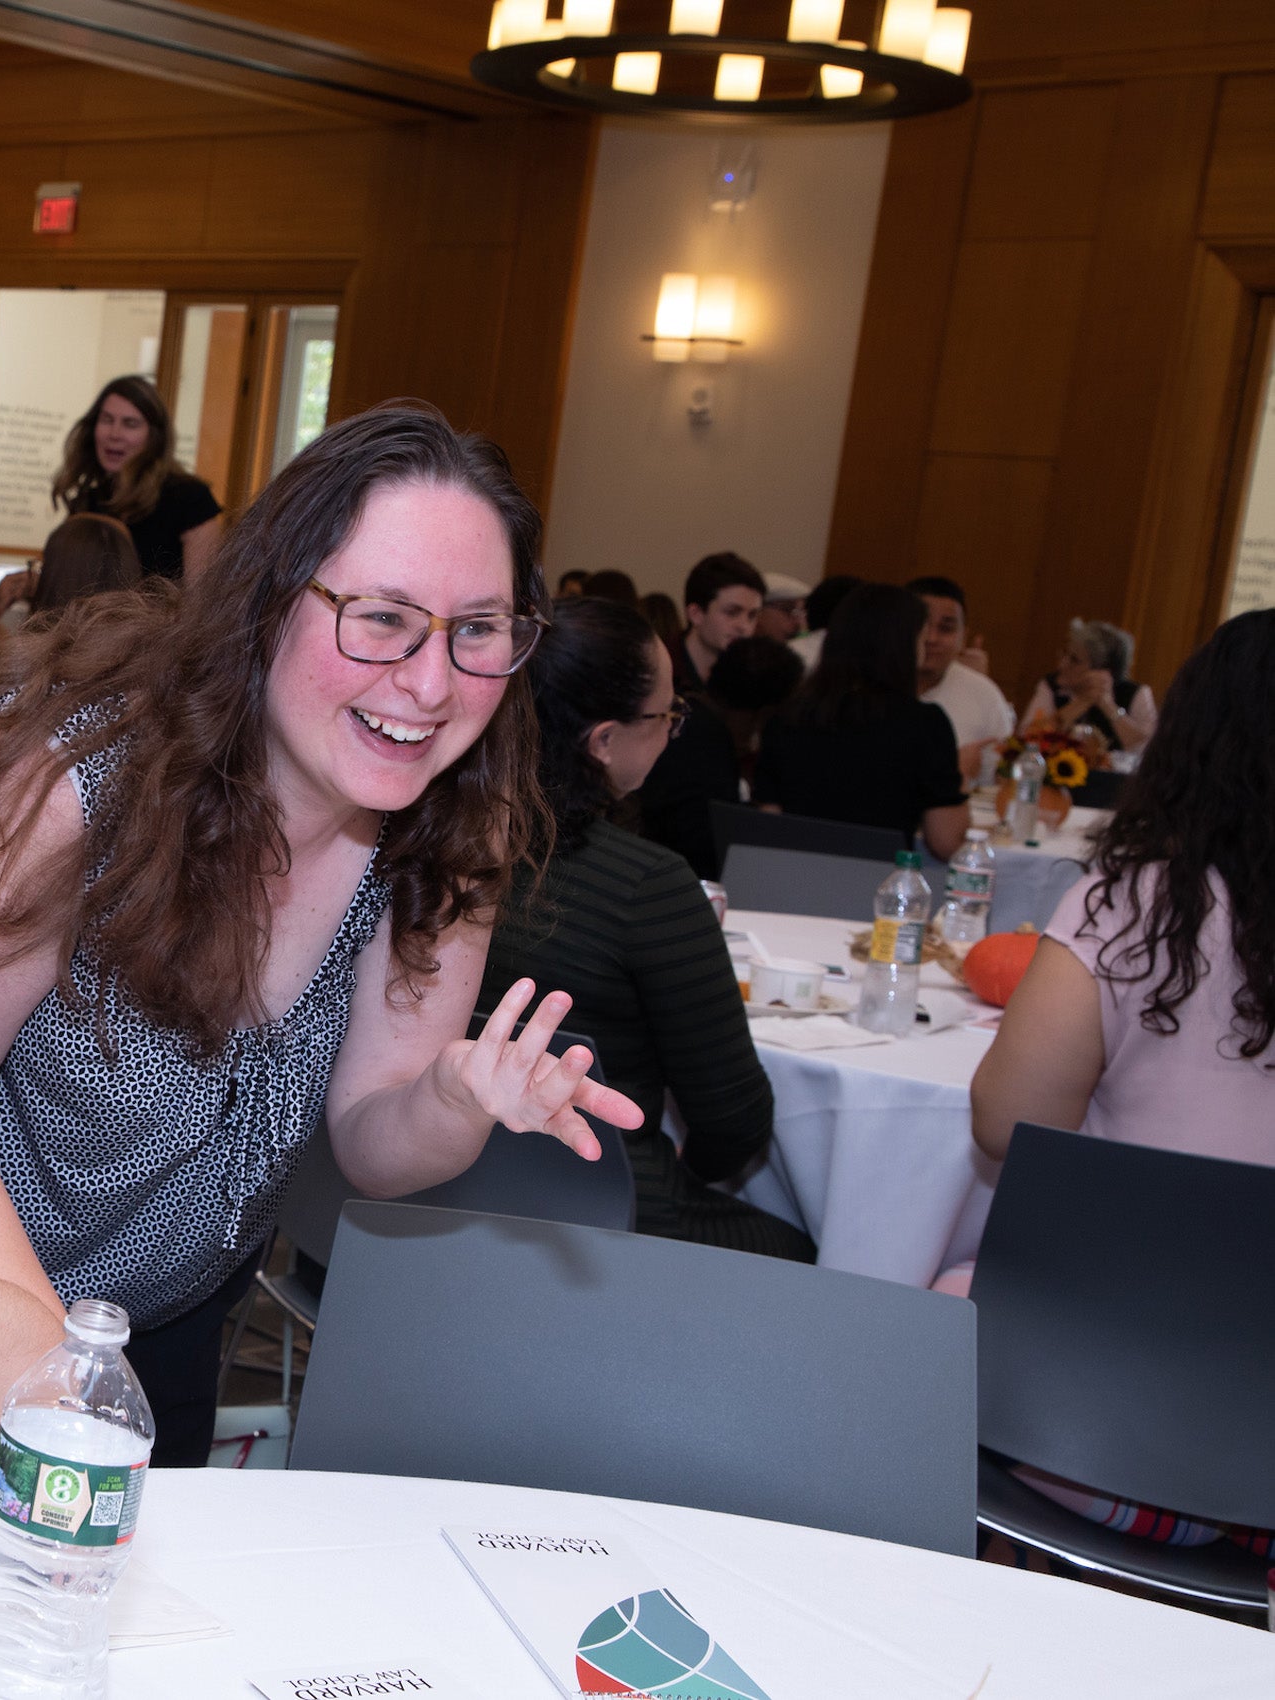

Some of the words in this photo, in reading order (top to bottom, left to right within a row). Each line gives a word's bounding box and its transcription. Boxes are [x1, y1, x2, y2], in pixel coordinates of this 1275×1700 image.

[99, 1482, 110, 1490] FOR
[111, 1482, 125, 1490] MORE
[41, 1509, 73, 1522] CONSERVE
[42, 1516, 70, 1529] SPRINGS
[472, 1532, 555, 1543] SCHOOL
[562, 1537, 601, 1546] LAW
[477, 1539, 610, 1556] HARVARD
[283, 1673, 371, 1689] SCHOOL
[375, 1668, 417, 1681] LAW
[294, 1678, 434, 1700] HARVARD
